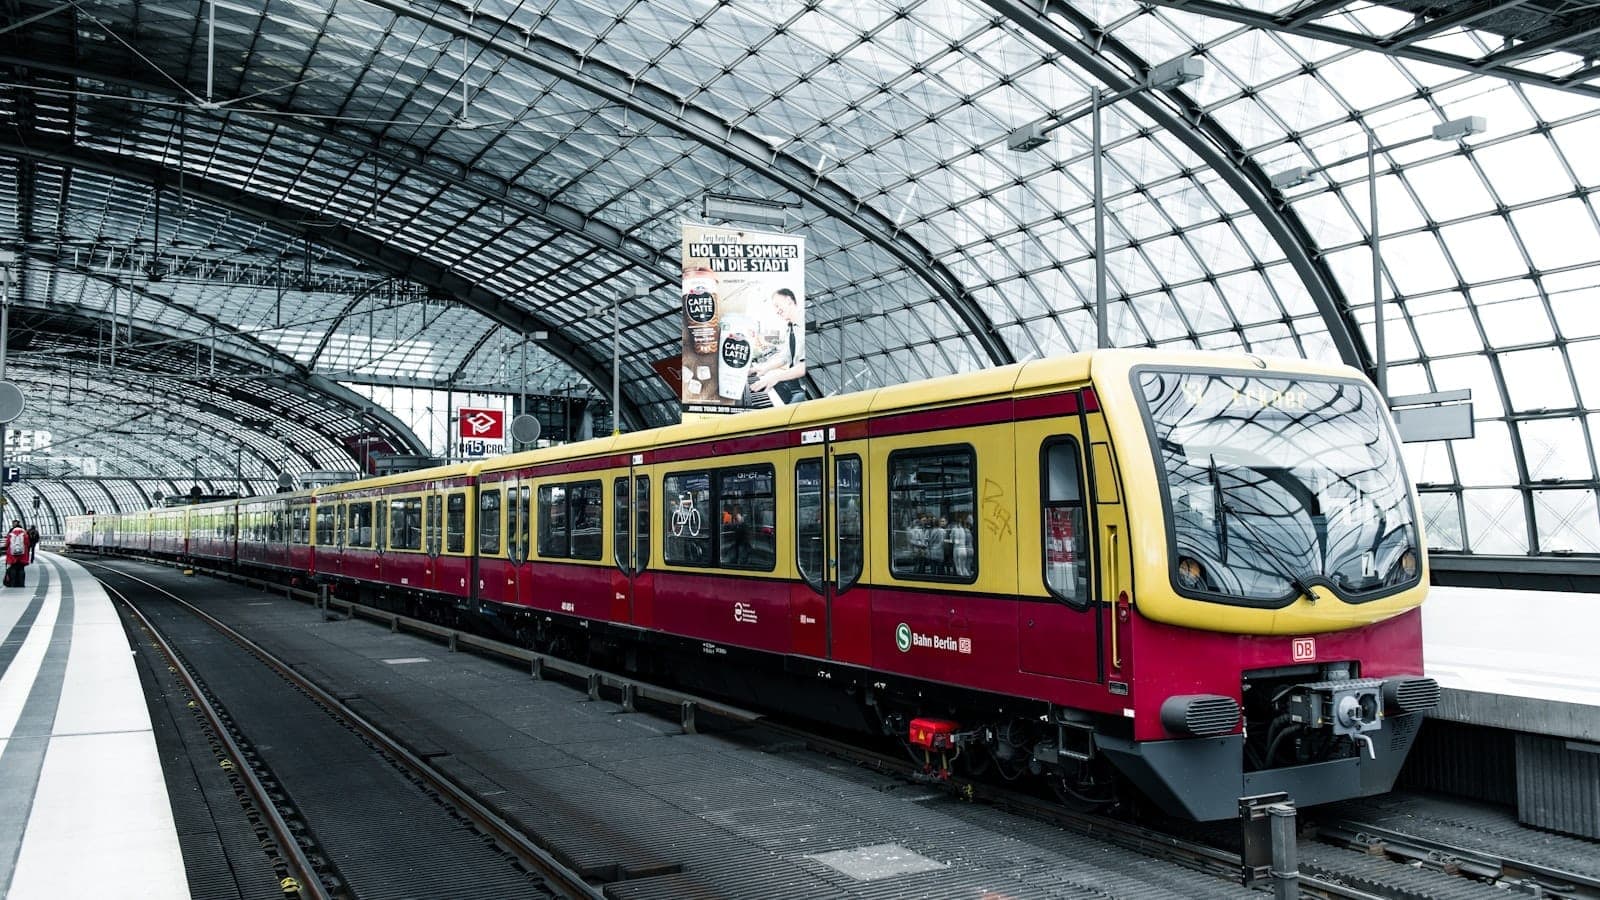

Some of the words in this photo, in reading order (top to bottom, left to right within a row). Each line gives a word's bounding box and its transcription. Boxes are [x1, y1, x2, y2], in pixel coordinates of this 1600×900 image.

[691, 244, 717, 257] HOL
[719, 244, 744, 257] DEN
[746, 245, 798, 258] SOMMER
[712, 258, 726, 272] IN
[728, 259, 748, 272] DIE
[751, 259, 787, 272] STADT
[690, 305, 713, 313] LATTE
[724, 350, 747, 360] LATTE
[469, 441, 482, 453] 15
[8, 468, 18, 480] F
[898, 625, 910, 649] S
[913, 632, 933, 648] Bahn
[933, 635, 957, 651] Berlin
[1296, 641, 1313, 658] DB
